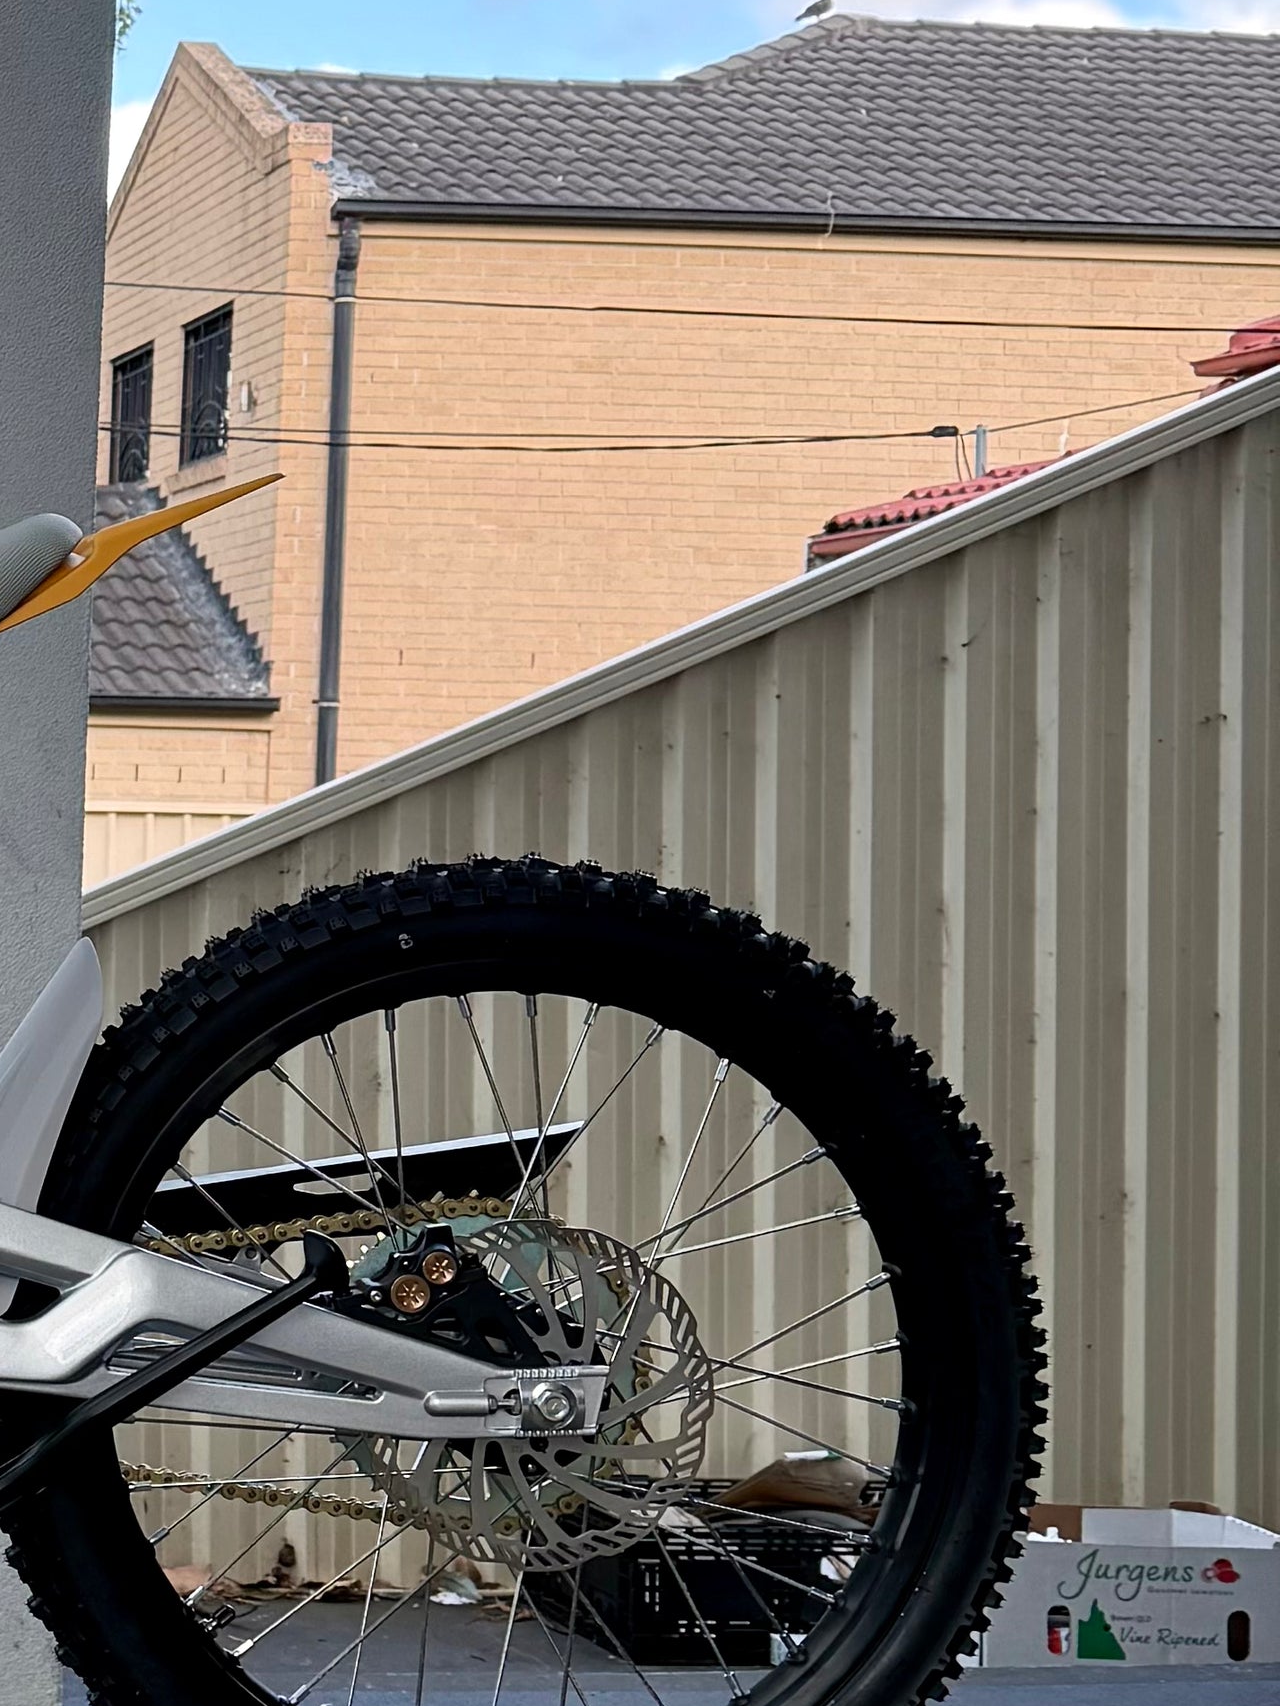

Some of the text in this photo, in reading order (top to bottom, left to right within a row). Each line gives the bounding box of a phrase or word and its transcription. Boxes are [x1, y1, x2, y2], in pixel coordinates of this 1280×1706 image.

[1057, 1549, 1195, 1602] Jurgens
[1119, 1626, 1220, 1649] Vine Ripened
